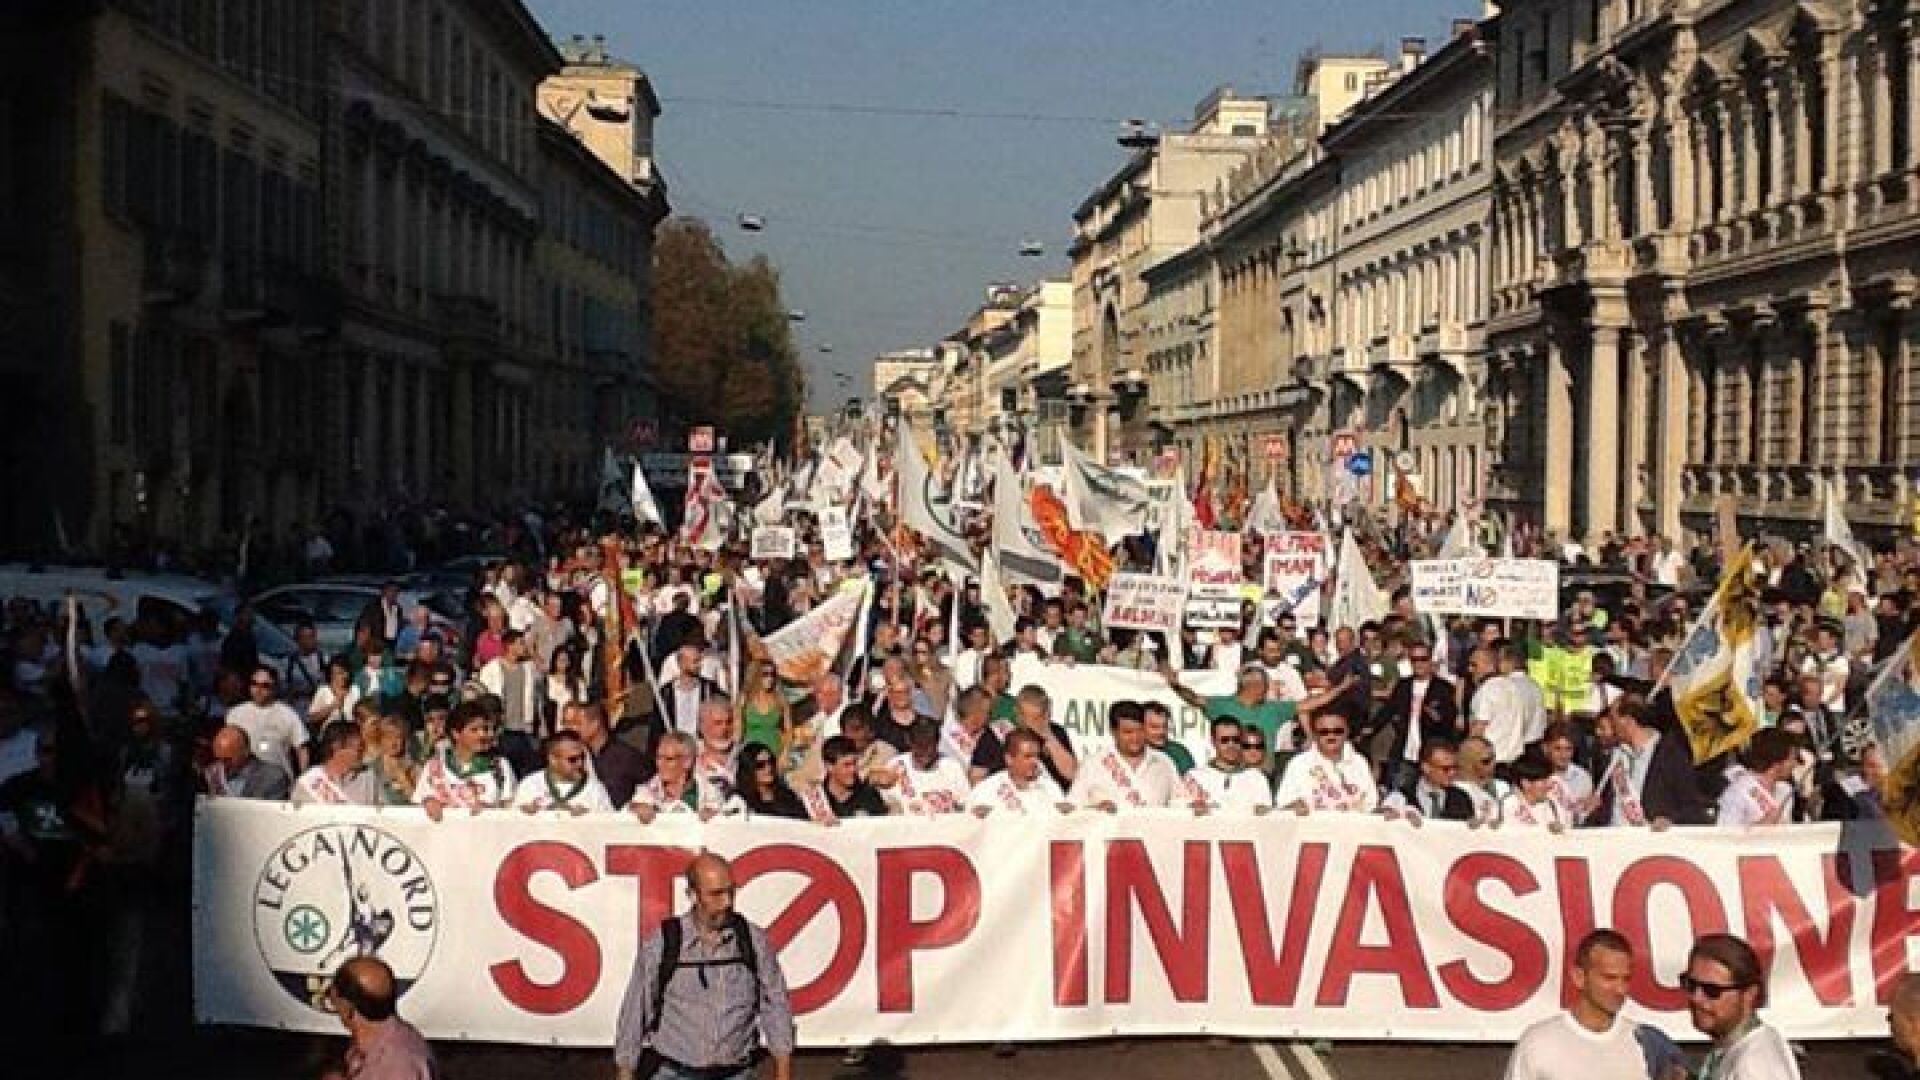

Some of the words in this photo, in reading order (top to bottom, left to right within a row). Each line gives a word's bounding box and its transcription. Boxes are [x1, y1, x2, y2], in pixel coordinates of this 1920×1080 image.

[258, 833, 336, 910] LEGA
[352, 829, 434, 931] NORD
[488, 839, 983, 1016] STOP
